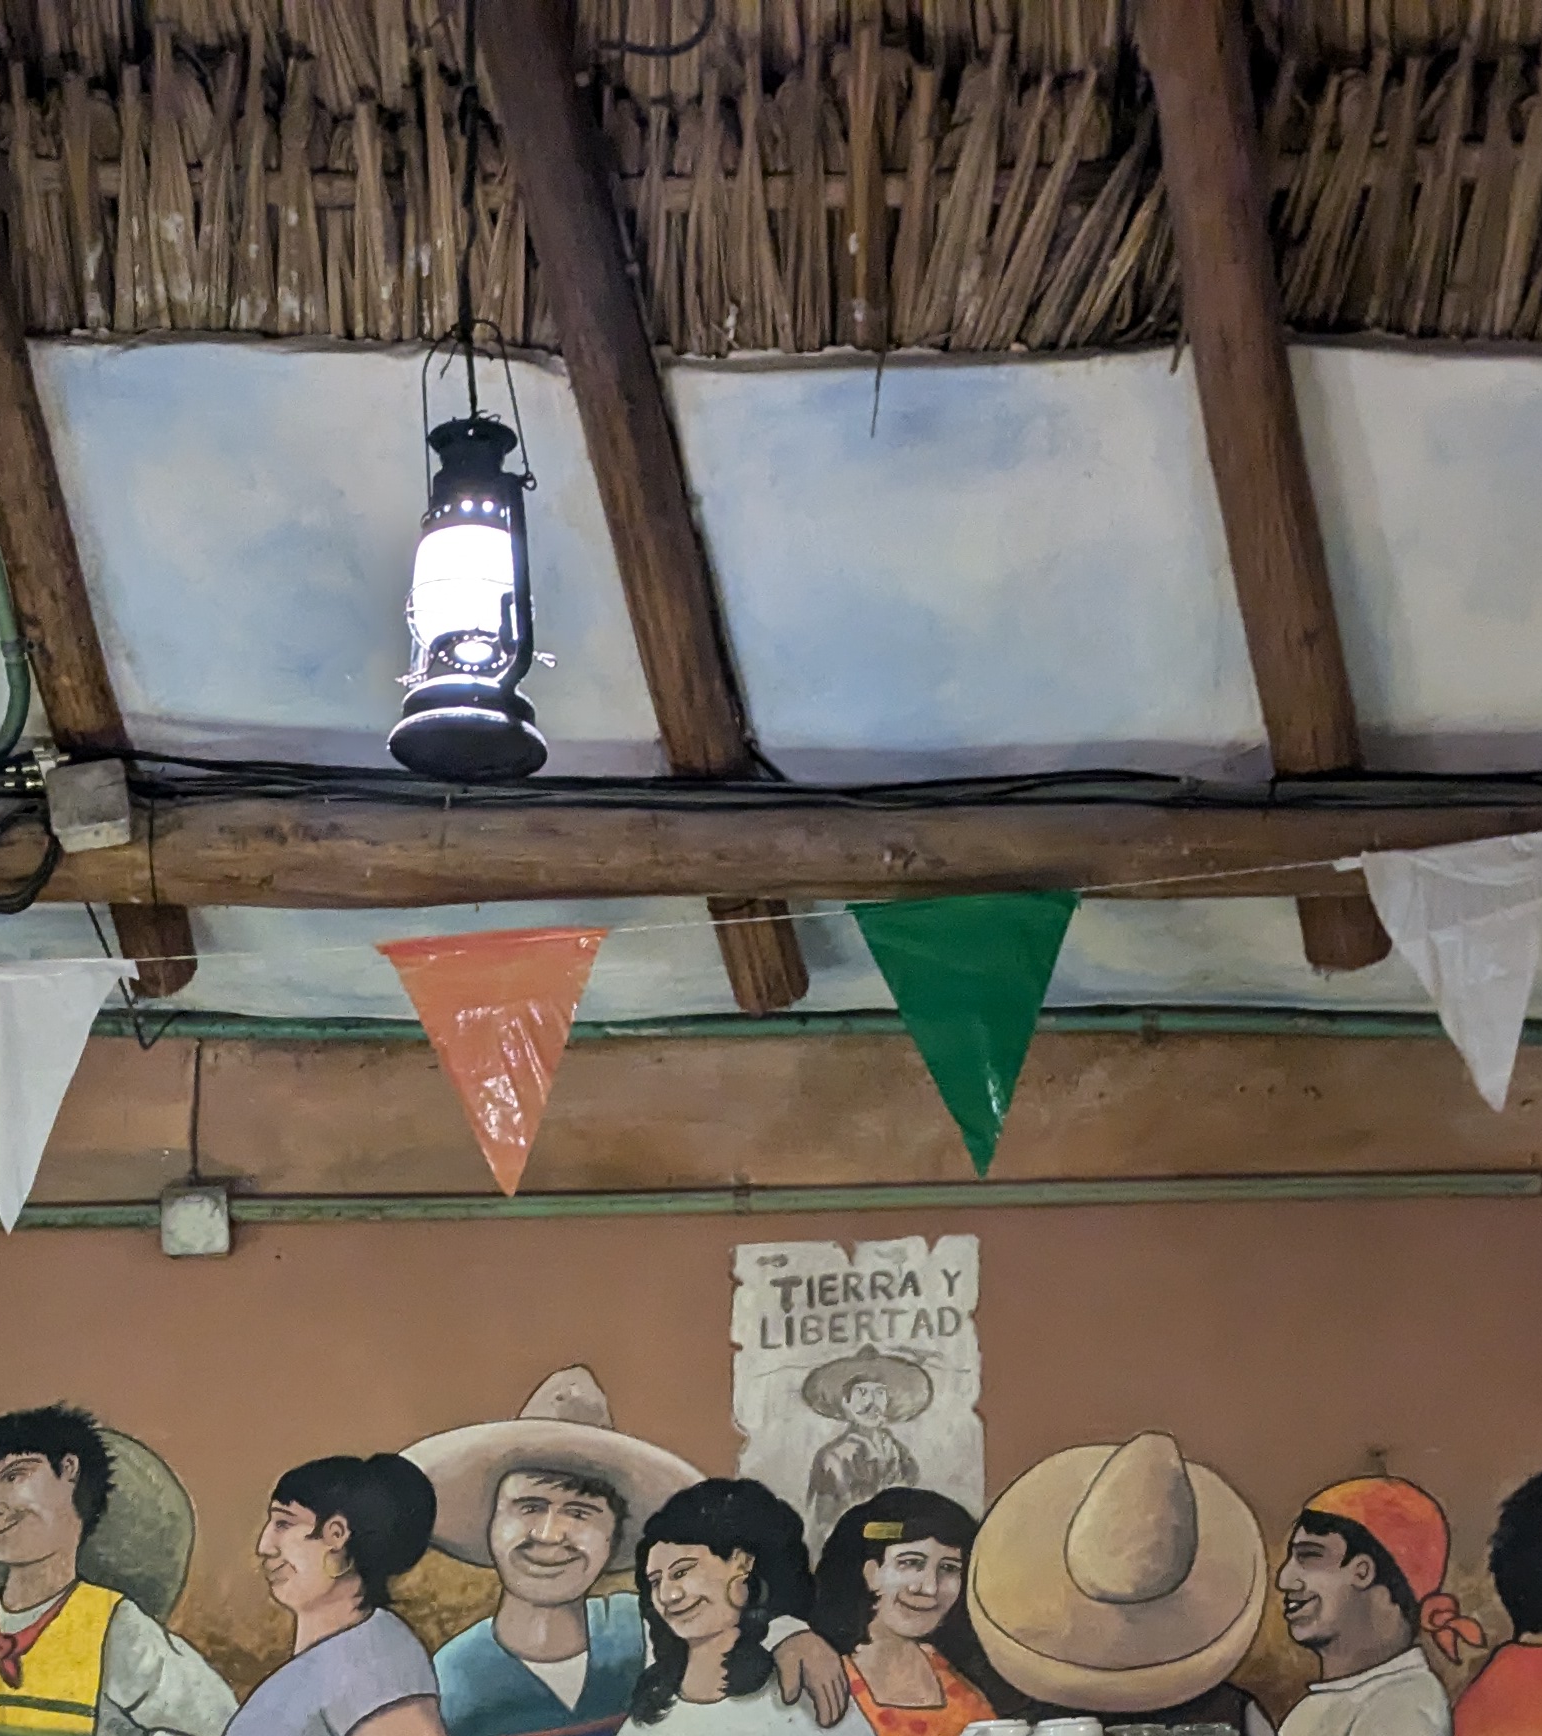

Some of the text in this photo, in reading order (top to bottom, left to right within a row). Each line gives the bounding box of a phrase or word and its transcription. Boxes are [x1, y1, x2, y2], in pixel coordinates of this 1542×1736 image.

[769, 1268, 962, 1314] TIERRA Y
[760, 1306, 961, 1349] LIBERTAD
